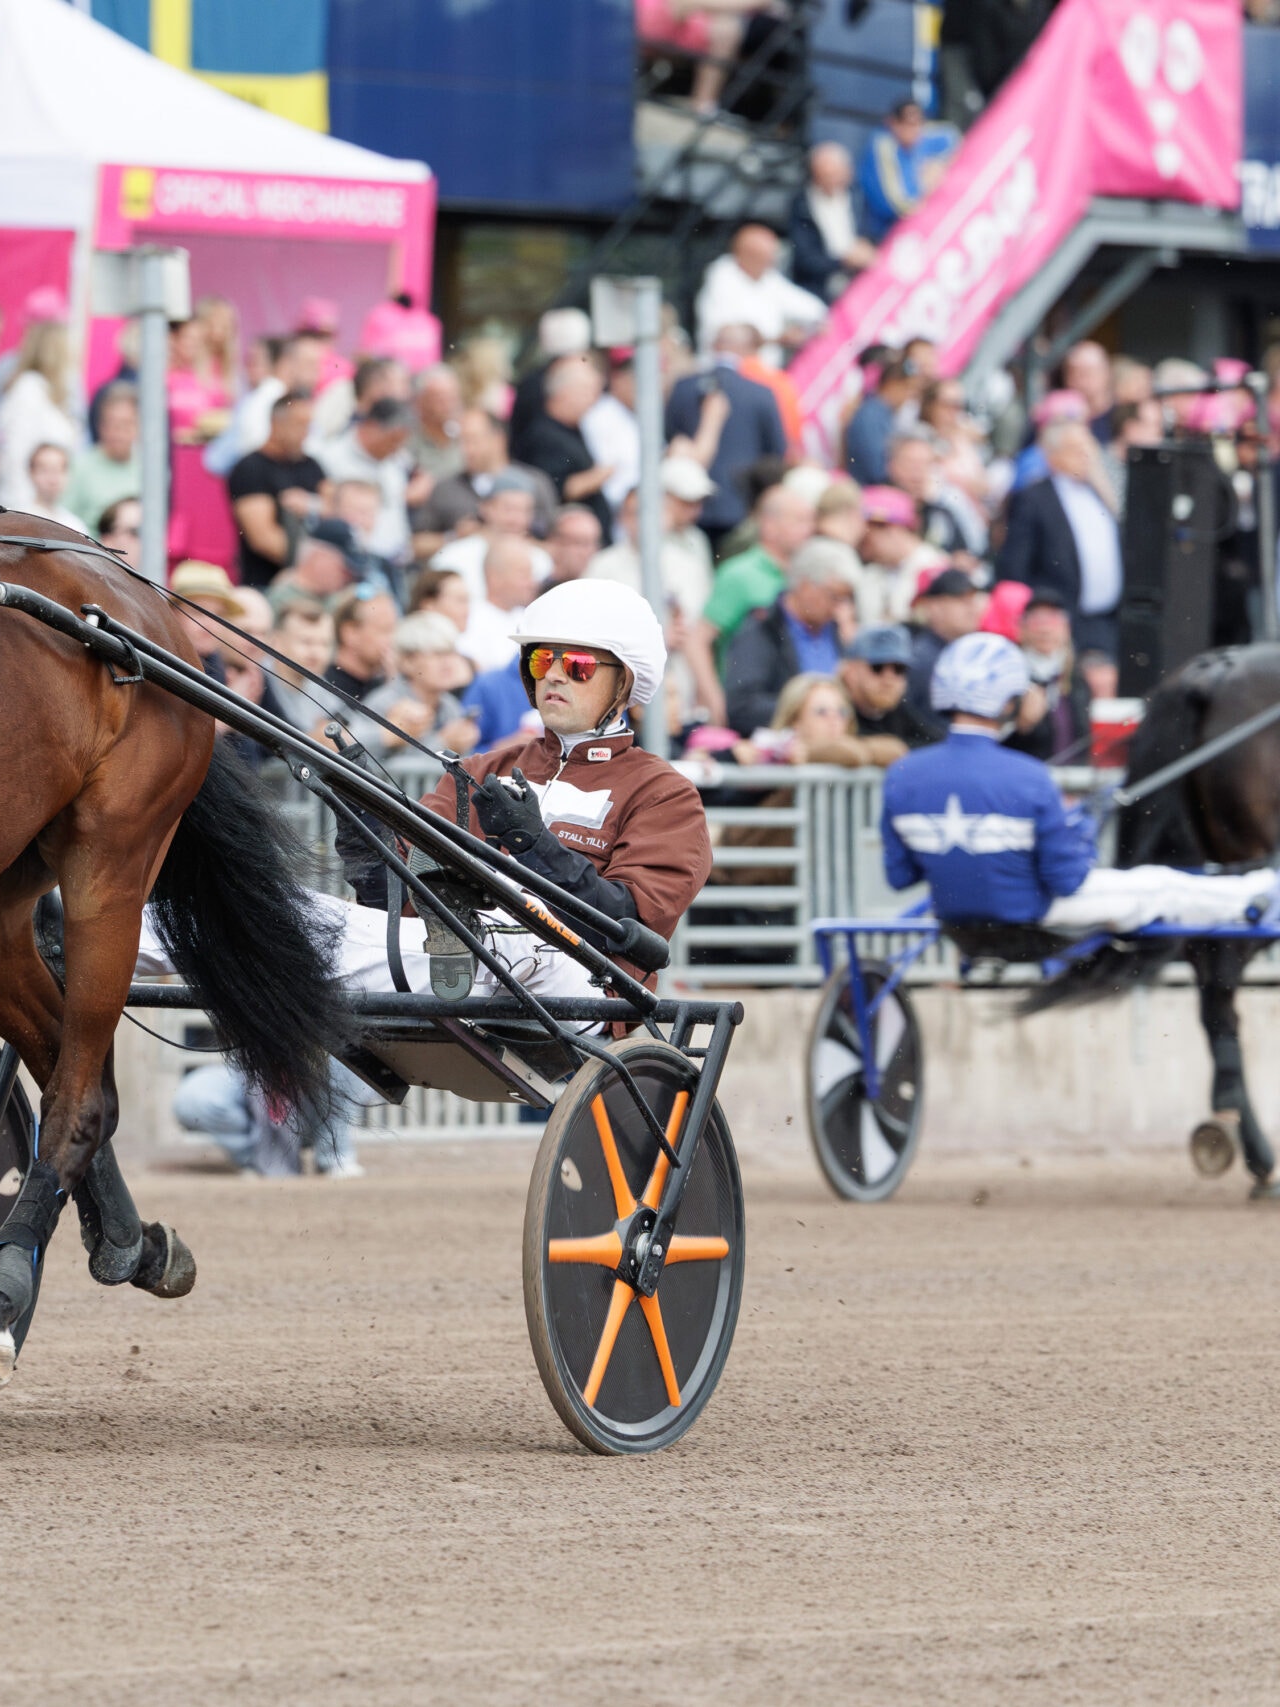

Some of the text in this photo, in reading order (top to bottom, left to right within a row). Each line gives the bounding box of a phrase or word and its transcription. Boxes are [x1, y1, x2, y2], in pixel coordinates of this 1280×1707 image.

[558, 830, 608, 850] STALL TILLY
[526, 899, 580, 946] YANKEE
